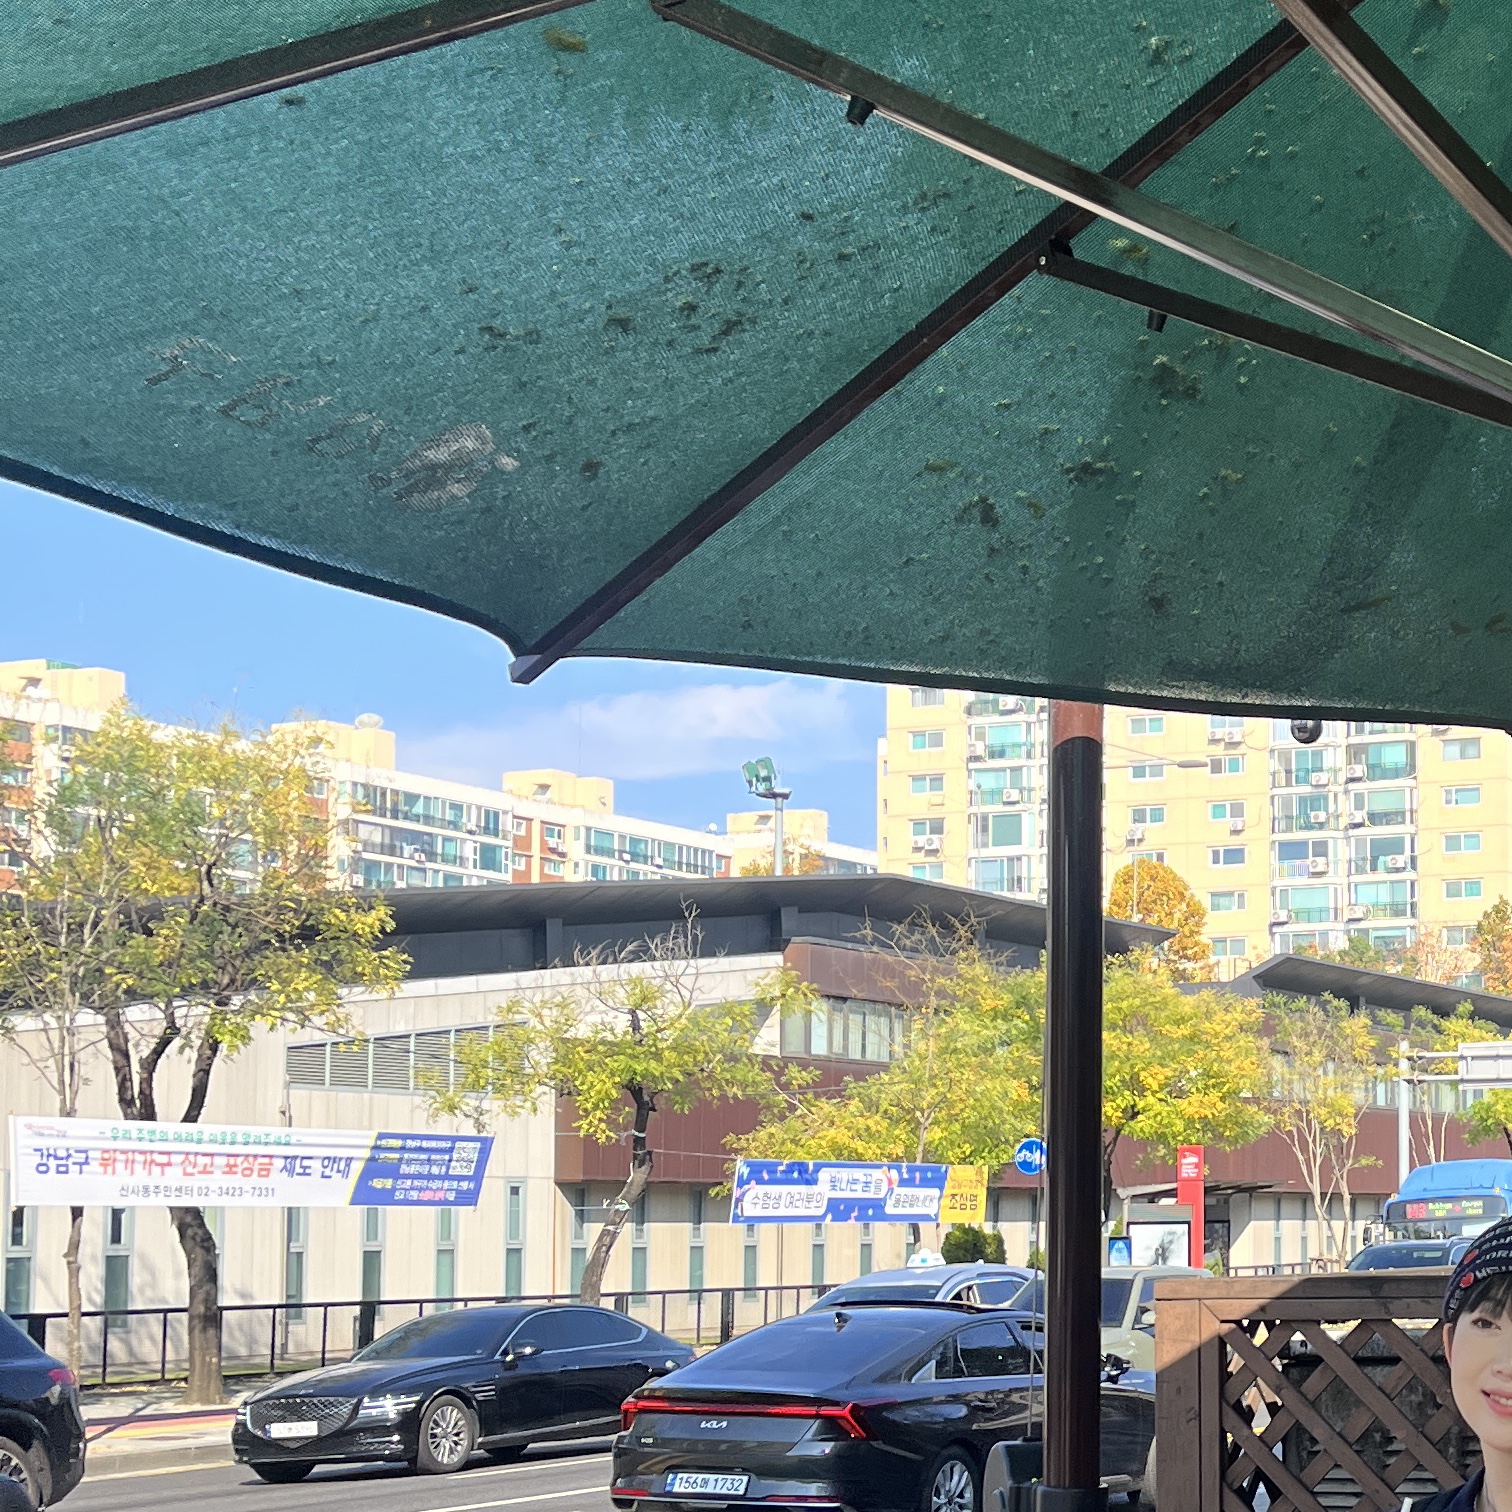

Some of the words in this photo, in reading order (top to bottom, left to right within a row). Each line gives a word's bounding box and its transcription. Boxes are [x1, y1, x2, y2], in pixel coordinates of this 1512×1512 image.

[33, 1147, 91, 1175] 강남구
[99, 1149, 172, 1176] 위기가구
[180, 1152, 215, 1177] 신고
[279, 1154, 314, 1179] 제도
[320, 1155, 354, 1180] 안내
[119, 1184, 194, 1198] 신사동주민센터
[197, 1185, 276, 1198] 02-3423-7331
[750, 1190, 783, 1210] 수험생
[784, 1190, 825, 1210] 여러분의
[712, 1477, 744, 1492] 1732
